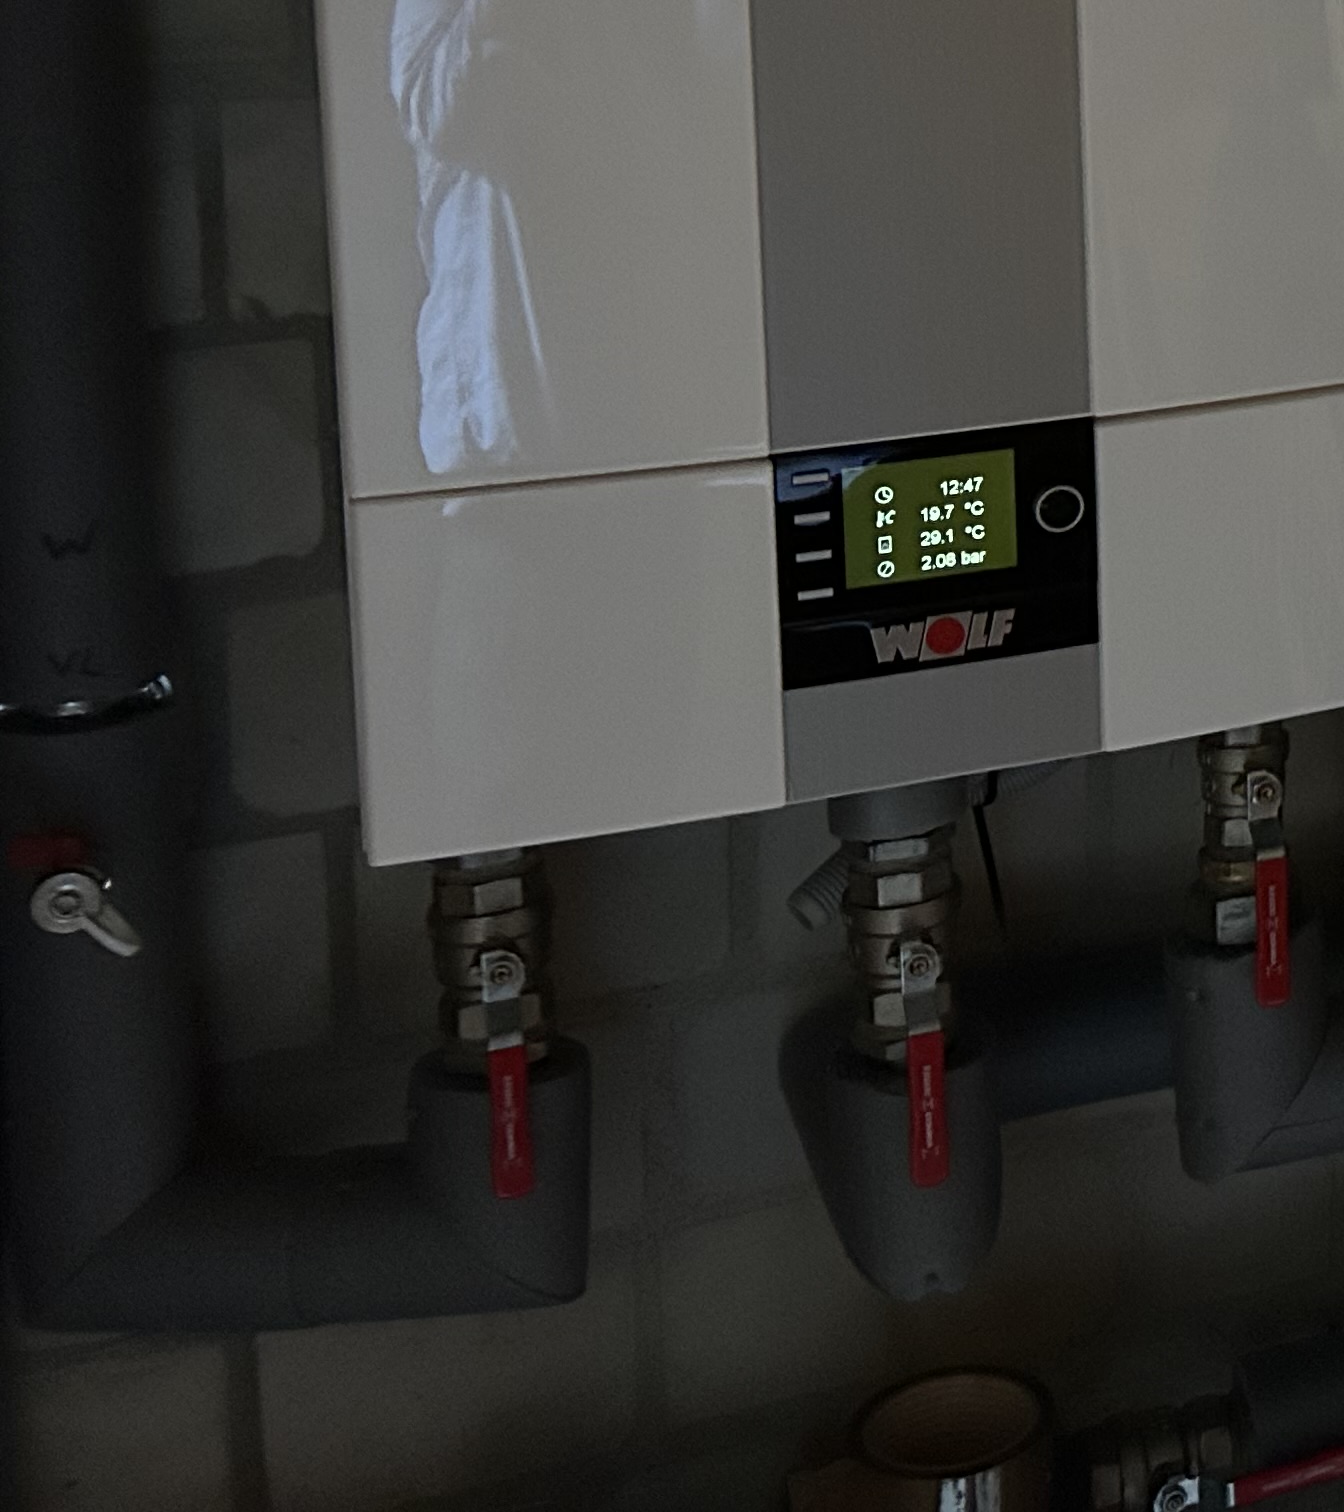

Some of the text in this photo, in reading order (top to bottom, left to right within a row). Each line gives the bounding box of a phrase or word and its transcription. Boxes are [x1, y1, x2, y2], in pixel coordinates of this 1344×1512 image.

[940, 476, 984, 496] 12:47
[920, 500, 985, 522] 19.7 °C
[964, 524, 986, 540] °C
[921, 550, 987, 571] 2.08 bar
[869, 607, 1016, 664] WOLF
